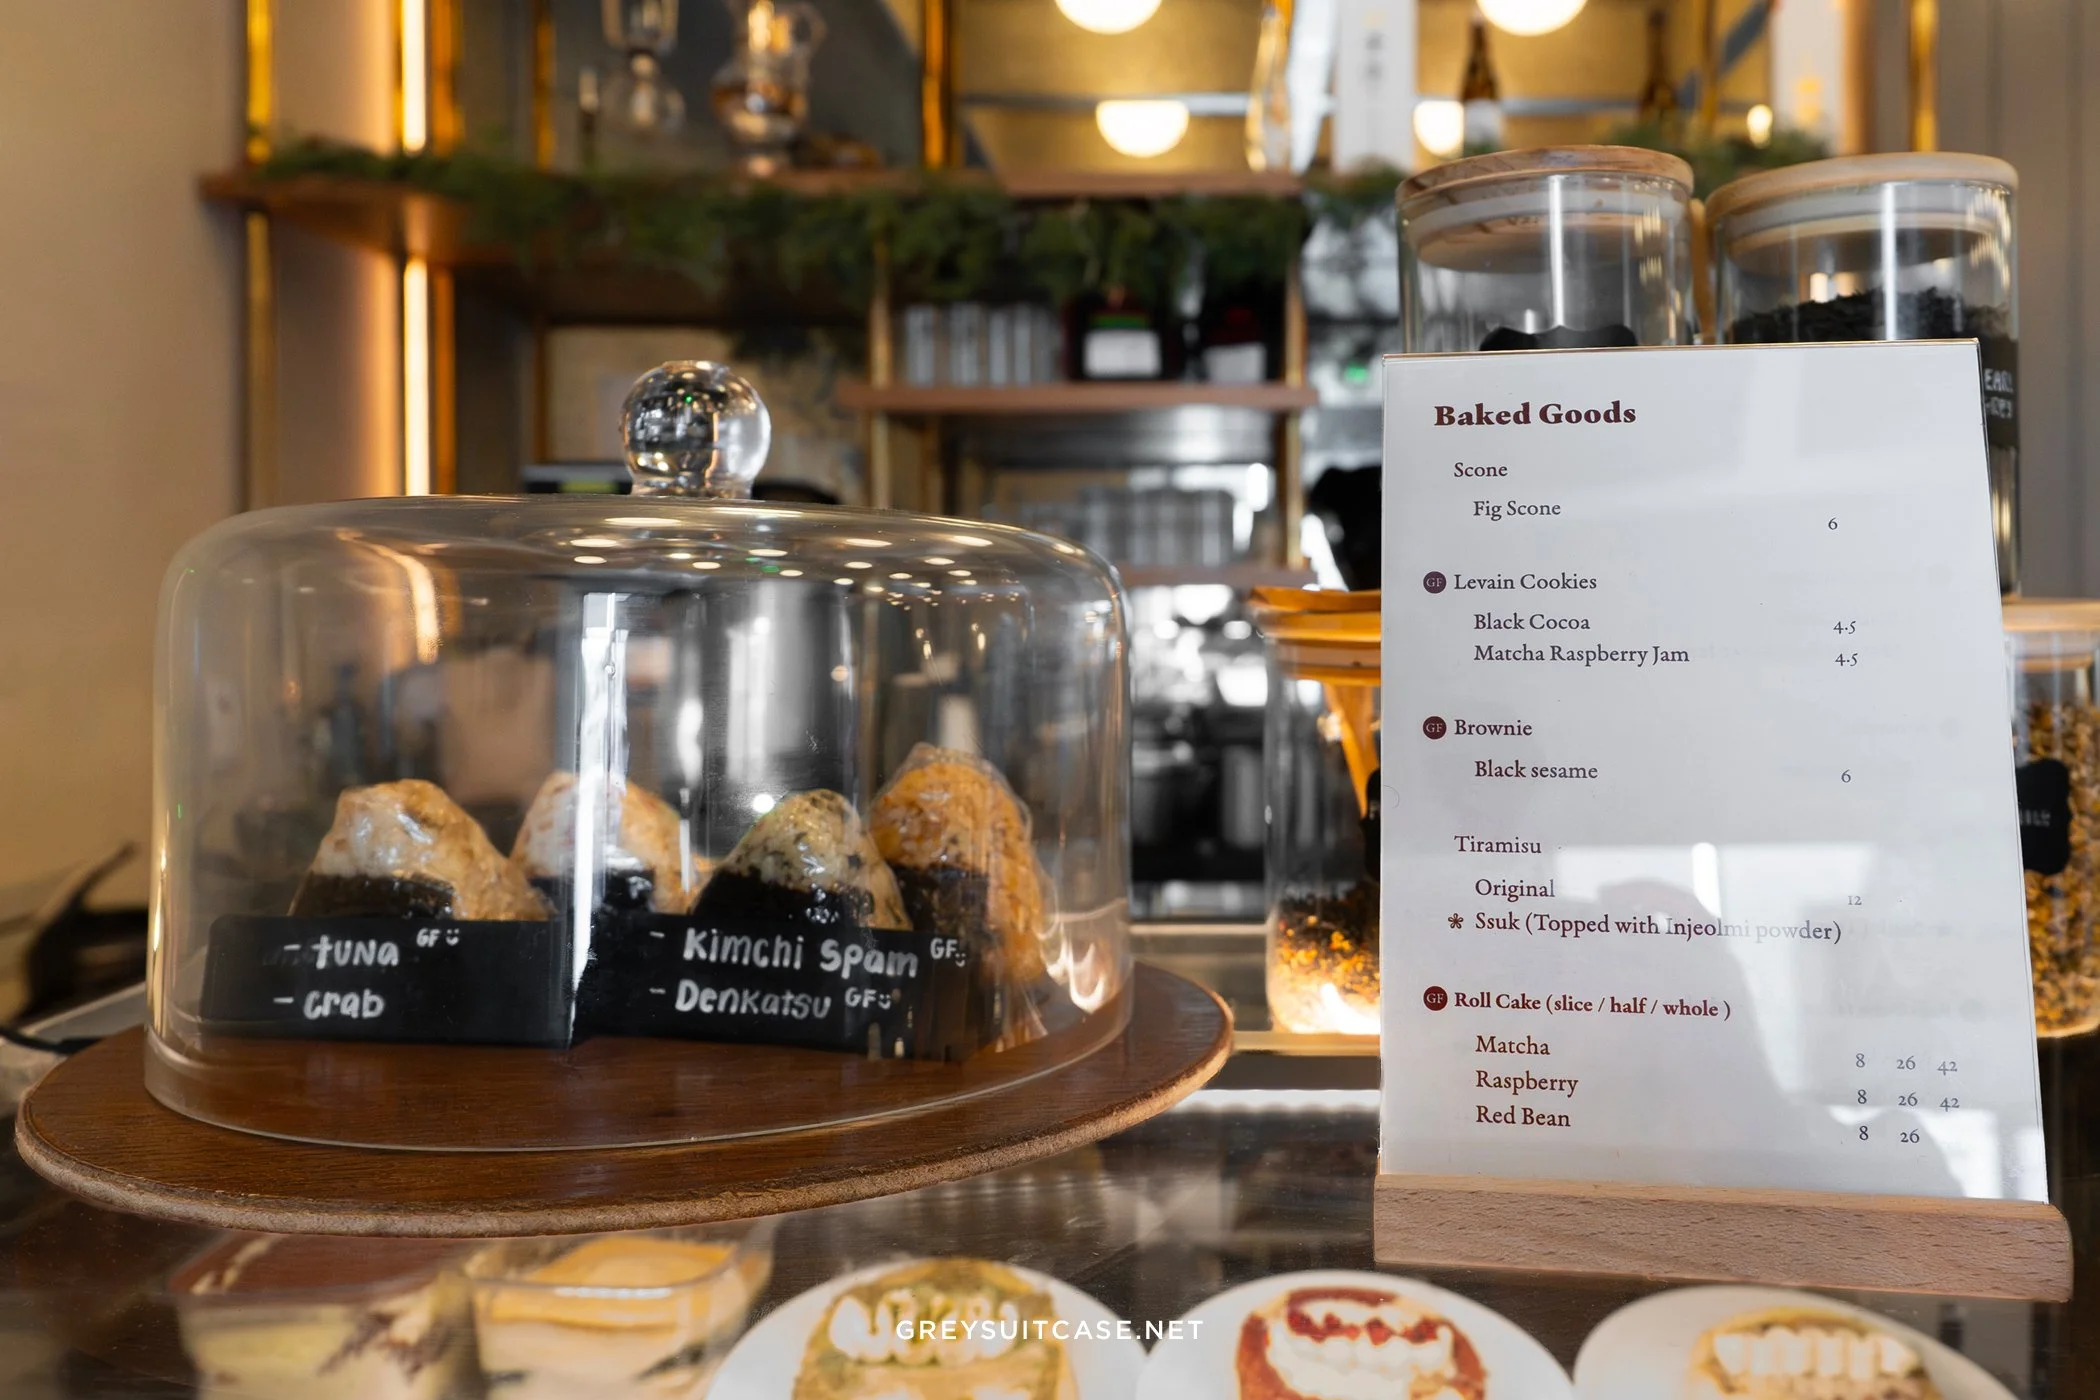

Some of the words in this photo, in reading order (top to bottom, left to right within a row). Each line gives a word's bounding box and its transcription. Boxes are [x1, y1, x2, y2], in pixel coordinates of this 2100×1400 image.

[1434, 402, 1531, 426] Baked
[1539, 400, 1637, 425] Goods
[1453, 461, 1508, 478] Scone
[1473, 501, 1502, 522] Fig
[1506, 500, 1562, 517] Scone
[1828, 517, 1839, 531] 6
[1454, 573, 1515, 590] Levain
[1520, 573, 1598, 590] Cookies
[1474, 613, 1524, 631] Black
[1529, 613, 1591, 630] Cocoa
[1474, 644, 1545, 662] Matcha
[1550, 644, 1647, 667] Raspberry
[1652, 645, 1690, 665] Jam
[1454, 718, 1533, 736] Brownie
[1474, 759, 1526, 779] Black
[1531, 766, 1598, 780] sesame
[1841, 769, 1852, 783] 6
[1454, 835, 1542, 854] Tiramisu
[1475, 879, 1555, 904] Original
[1475, 912, 1521, 932] Ssuk
[1525, 914, 1611, 937] (Topped
[1615, 915, 1661, 936] with
[1665, 918, 1750, 943] Injeolmi
[1756, 920, 1842, 944] powder)
[683, 927, 804, 969] Kimchi
[819, 938, 918, 979] Spam
[1426, 992, 1445, 1005] GF
[1454, 992, 1492, 1010] Roll
[1496, 993, 1541, 1012] Cake
[1546, 993, 1594, 1013] (slice
[1610, 995, 1647, 1014] half
[1663, 997, 1719, 1018] whole
[1475, 1035, 1551, 1056] Matcha
[1856, 1053, 1866, 1069] 8
[1897, 1056, 1917, 1071] 26
[1937, 1060, 1958, 1076] 42
[1475, 1070, 1579, 1099] Raspberry
[1857, 1089, 1868, 1105] 8
[1898, 1092, 1919, 1107] 26
[1939, 1097, 1960, 1112] 42
[1476, 1105, 1517, 1125] Red
[1521, 1107, 1571, 1128] Bean
[1859, 1126, 1869, 1142] 8
[1900, 1129, 1920, 1144] 26
